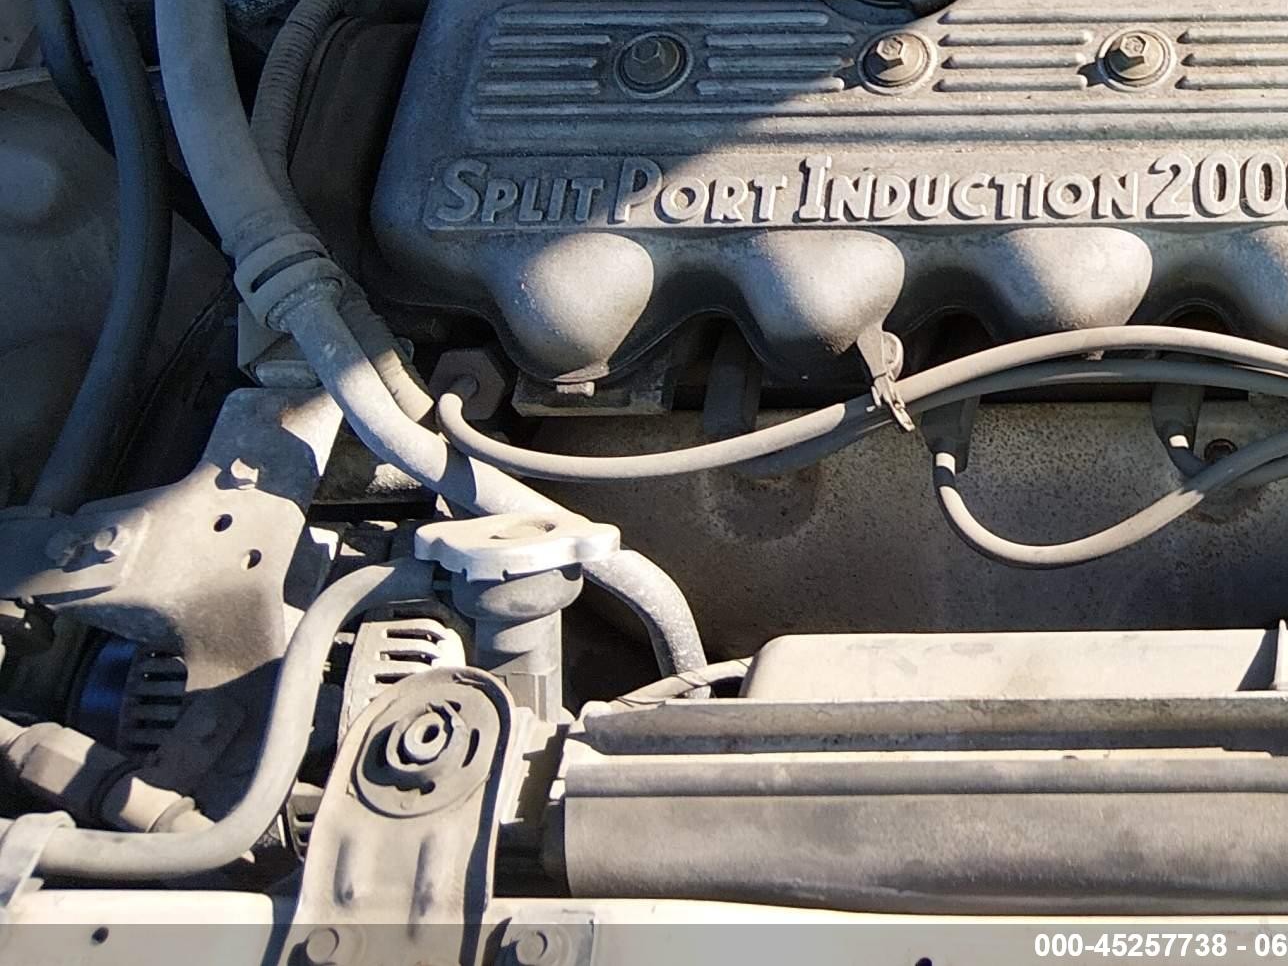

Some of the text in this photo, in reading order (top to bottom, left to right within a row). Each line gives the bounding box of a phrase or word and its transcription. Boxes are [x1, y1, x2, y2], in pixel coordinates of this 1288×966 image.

[435, 157, 604, 224] SPLIT
[607, 156, 788, 225] PORT
[791, 155, 1139, 223] INDUCTION
